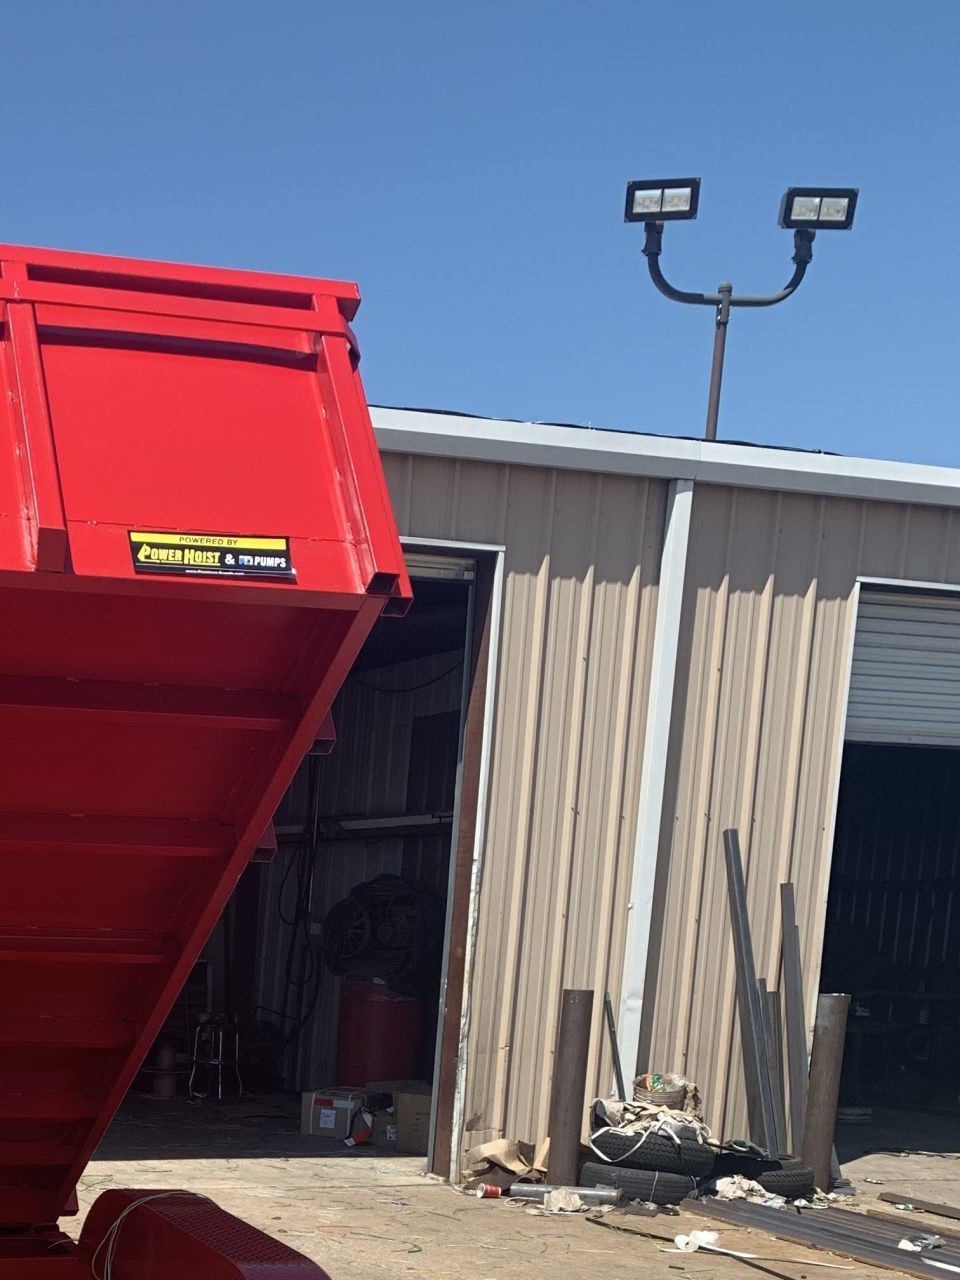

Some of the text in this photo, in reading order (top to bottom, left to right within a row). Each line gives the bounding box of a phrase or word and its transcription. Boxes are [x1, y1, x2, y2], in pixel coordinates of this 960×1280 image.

[179, 536, 224, 546] POWERED
[224, 553, 236, 565] &
[254, 555, 287, 568] PUMPS
